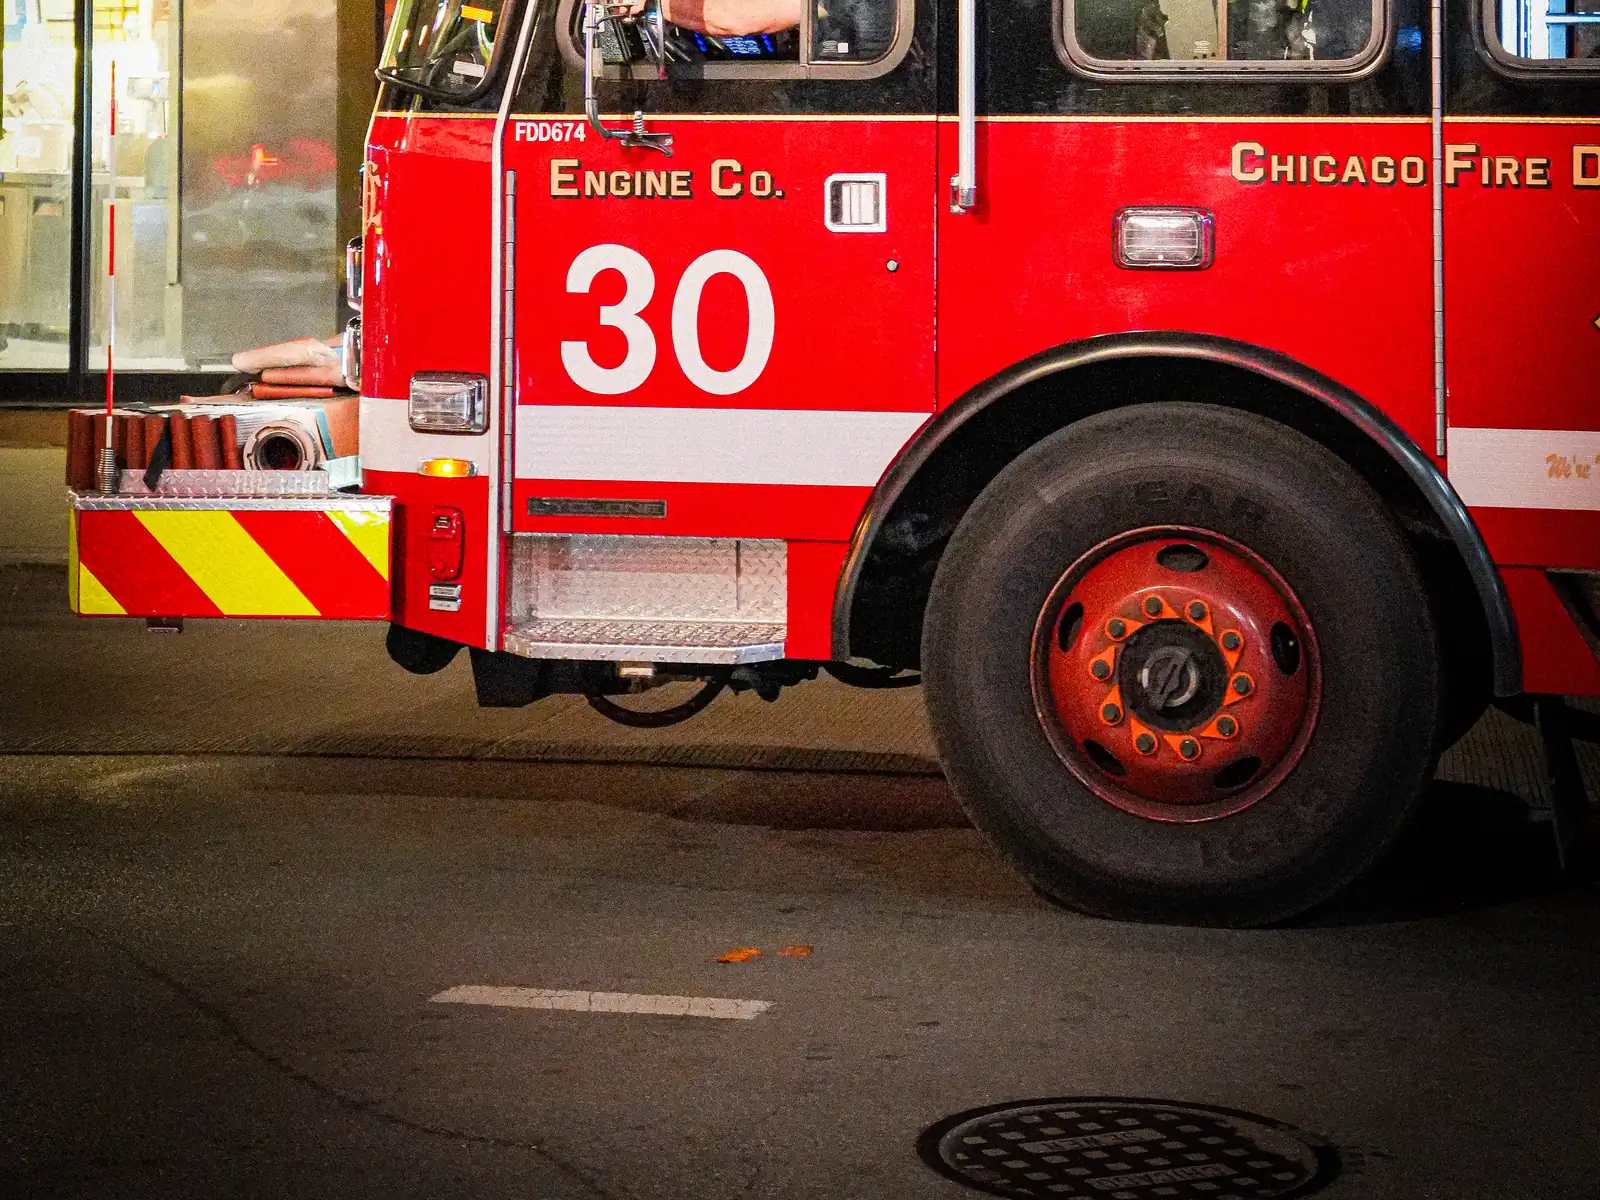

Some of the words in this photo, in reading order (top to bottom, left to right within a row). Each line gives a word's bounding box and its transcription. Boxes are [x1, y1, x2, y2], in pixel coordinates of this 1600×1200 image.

[514, 121, 586, 143] FDD674
[549, 158, 694, 199] ENGINE
[710, 158, 786, 200] CO.
[1231, 141, 1428, 187] CHICAGO
[1445, 143, 1552, 189] FIRE
[560, 243, 776, 396] 30
